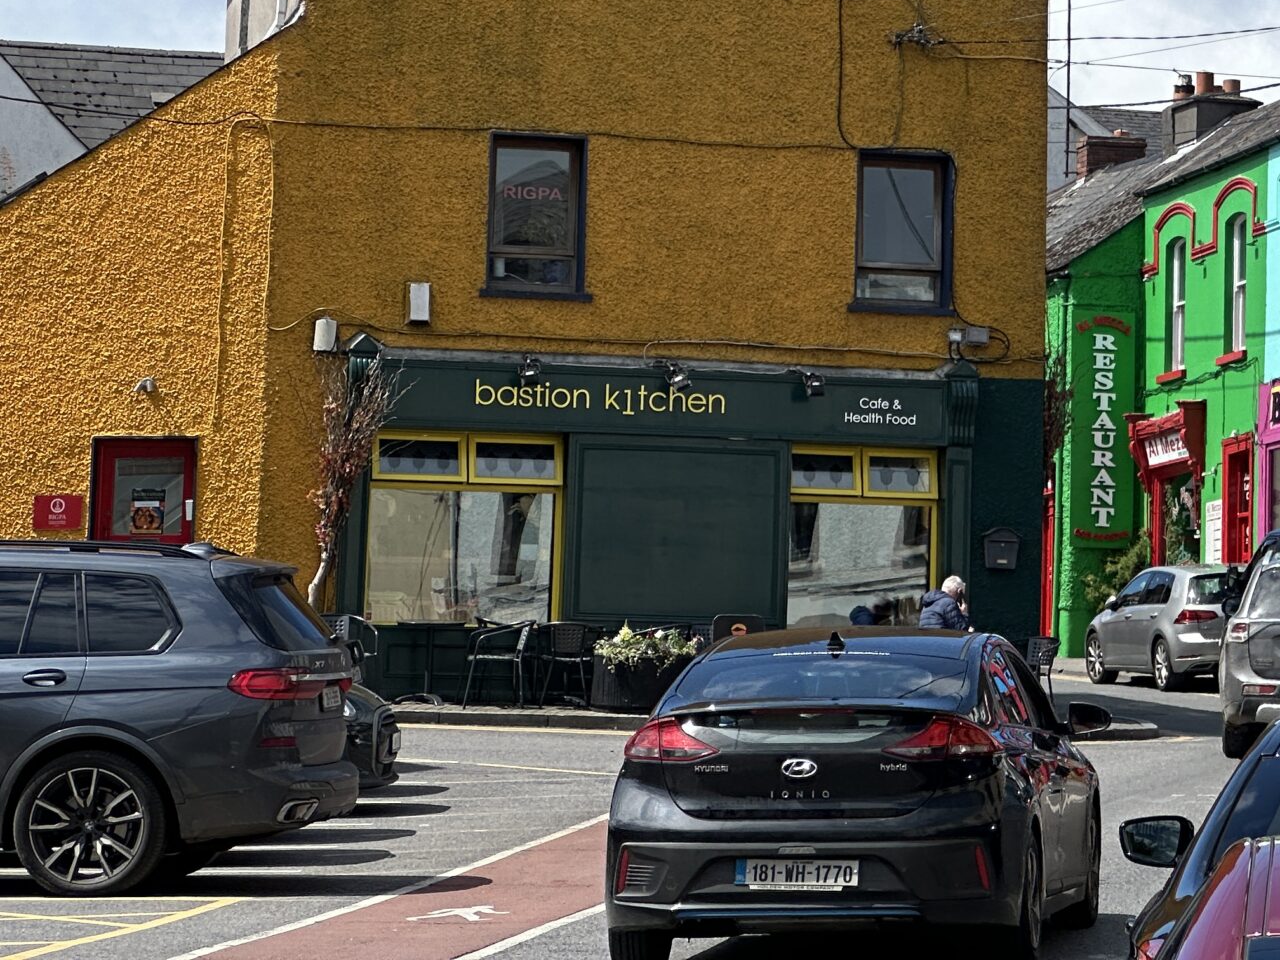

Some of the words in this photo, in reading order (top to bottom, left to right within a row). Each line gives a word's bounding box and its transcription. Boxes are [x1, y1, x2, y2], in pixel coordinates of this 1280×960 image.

[503, 184, 562, 201] RIGPA
[474, 378, 591, 409] bastion
[859, 397, 890, 410] Cafe
[892, 399, 902, 410] &
[844, 411, 883, 424] Health
[886, 413, 917, 426] Food
[1090, 333, 1118, 528] RESTAURANT
[314, 660, 325, 668] X7
[879, 763, 908, 772] hybrid
[752, 863, 853, 884] 181-WH-1770
